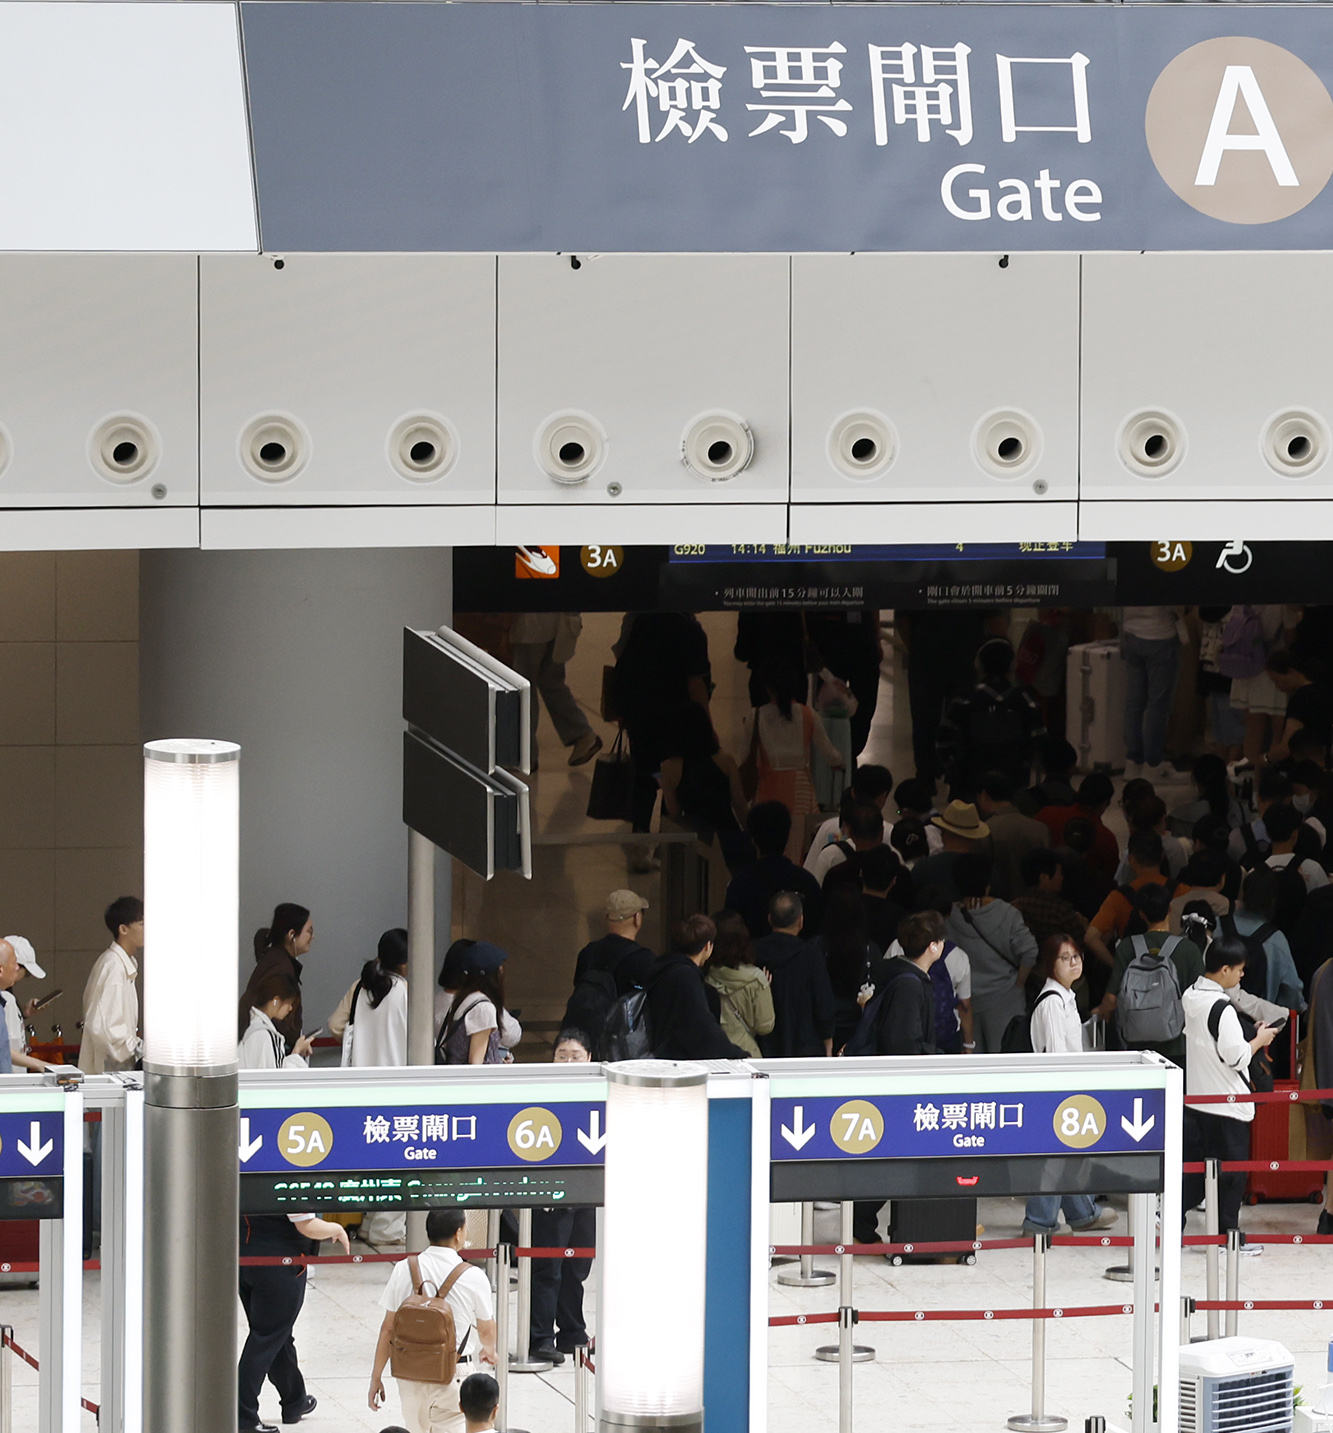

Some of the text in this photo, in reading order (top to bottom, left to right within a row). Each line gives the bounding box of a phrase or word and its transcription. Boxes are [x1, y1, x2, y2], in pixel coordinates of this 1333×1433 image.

[620, 37, 1092, 146] 檢票閘口
[1195, 65, 1300, 187] A
[941, 163, 1103, 222] Gate
[587, 545, 618, 568] 3A
[673, 544, 768, 556] G920 14:14
[1157, 540, 1188, 562] 3A
[363, 1113, 478, 1145] 檢票閘口
[841, 1112, 877, 1142] 7A
[913, 1101, 1025, 1133] 檢票閘口
[1060, 1106, 1099, 1137] 8A
[286, 1125, 326, 1154] 5A
[514, 1119, 555, 1150] 6A
[952, 1133, 985, 1148] Gate
[403, 1146, 437, 1160] Gate
